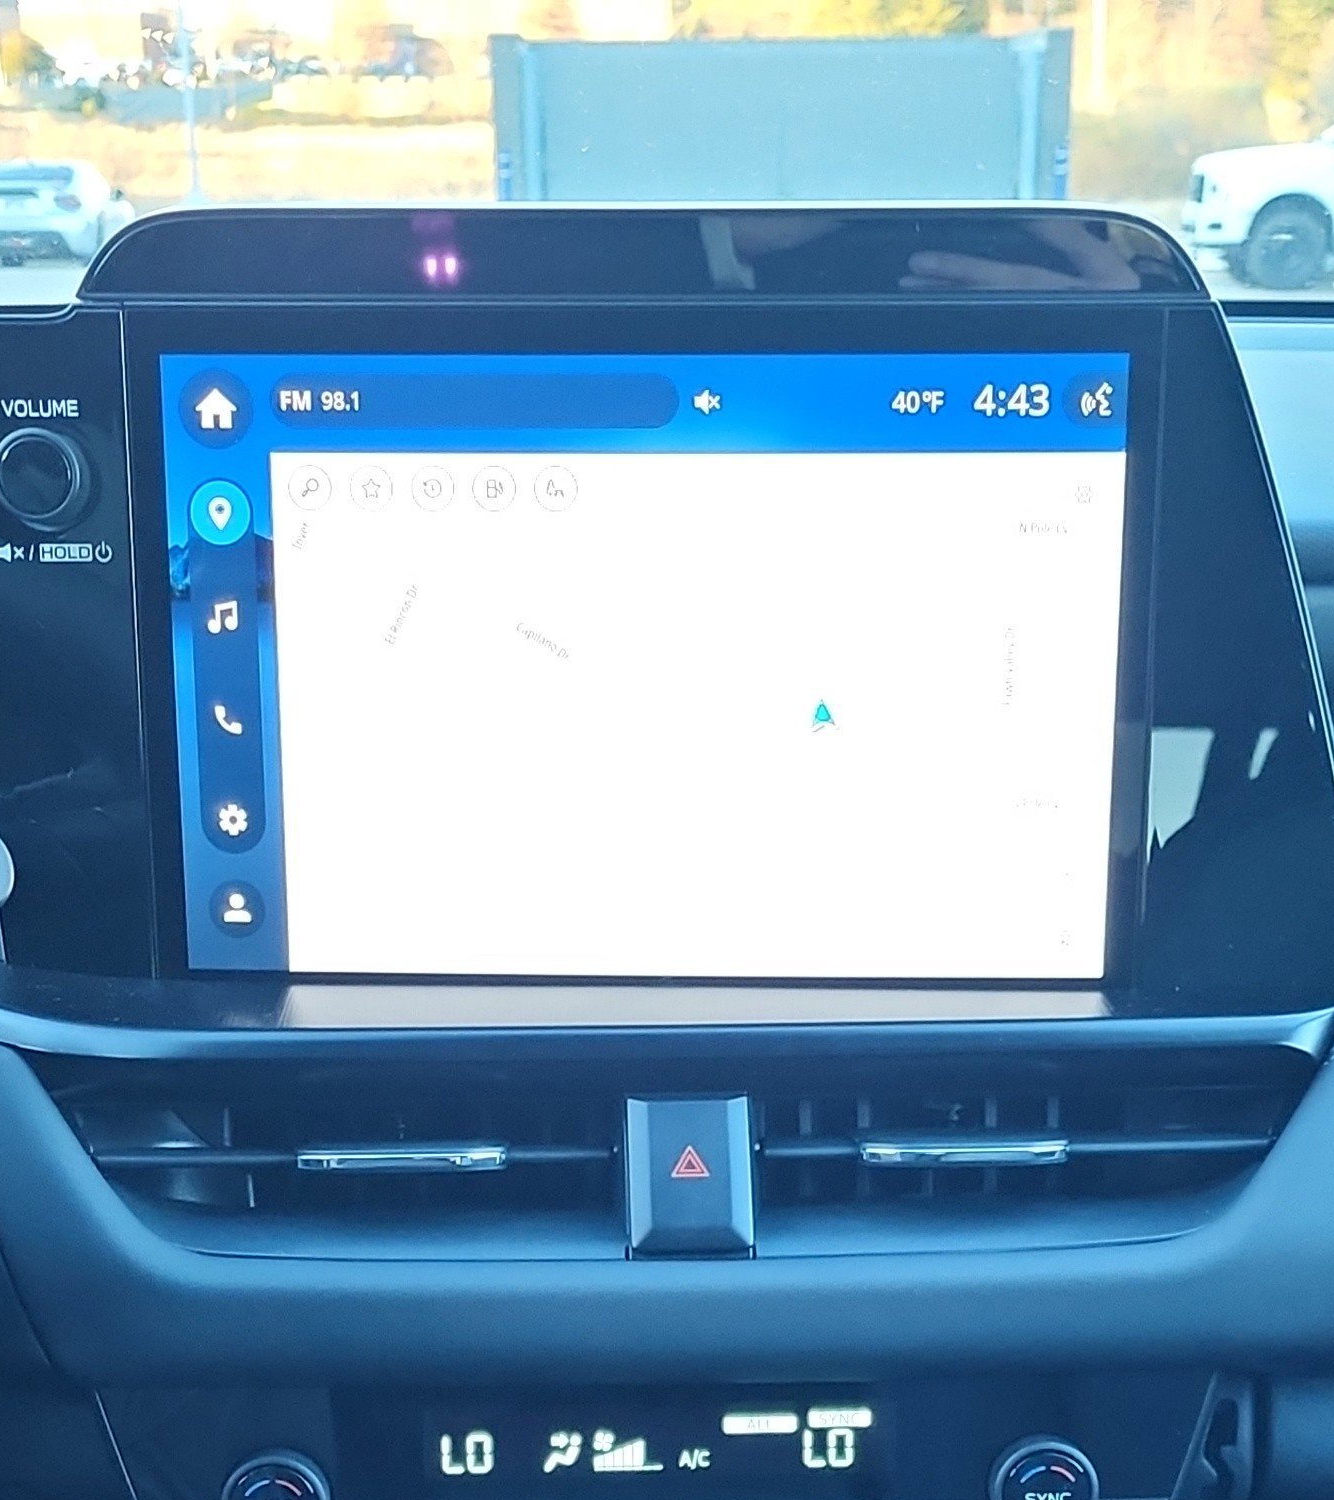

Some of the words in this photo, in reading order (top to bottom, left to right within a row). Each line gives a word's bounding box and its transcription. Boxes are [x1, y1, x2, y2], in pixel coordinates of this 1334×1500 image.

[1, 399, 78, 418] VOLUME
[280, 391, 311, 411] FM
[321, 392, 360, 412] 98.1
[891, 391, 944, 413] 40°F
[973, 384, 1050, 417] 4:43
[41, 545, 92, 561] HOLD
[440, 1432, 494, 1475] LO
[679, 1449, 711, 1469] A/C
[802, 1428, 855, 1469] LO
